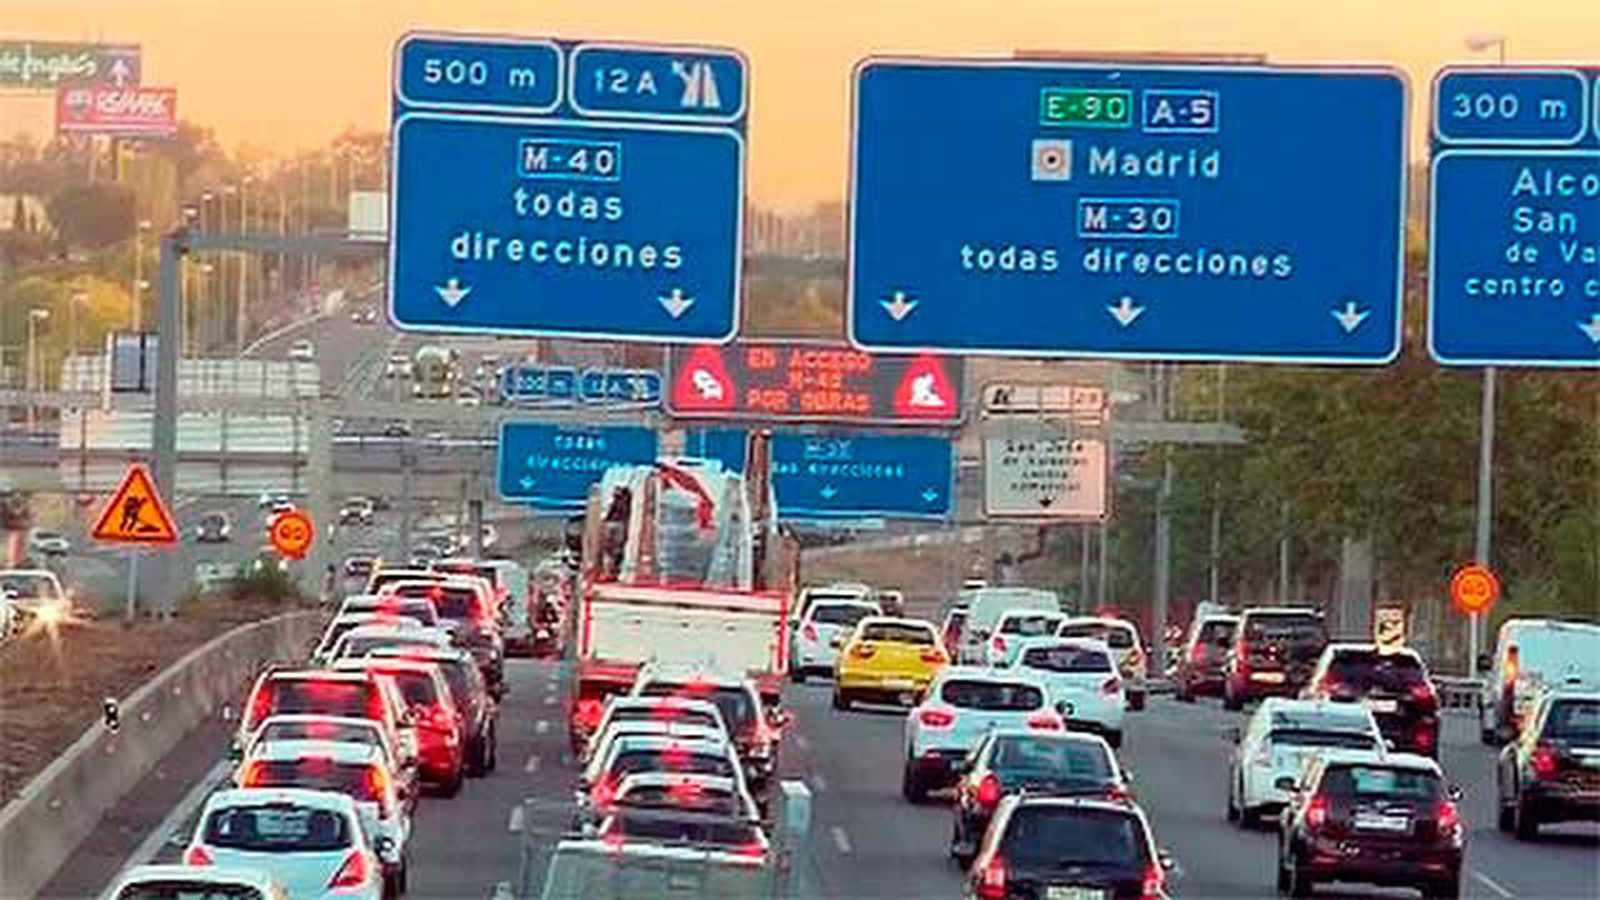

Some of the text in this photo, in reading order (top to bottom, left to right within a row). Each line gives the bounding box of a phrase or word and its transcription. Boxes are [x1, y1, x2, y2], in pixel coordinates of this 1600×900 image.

[423, 60, 536, 86] 500 m
[594, 68, 658, 95] 12A
[1045, 94, 1213, 124] E-90 A-5
[1452, 93, 1566, 119] 300 m
[523, 146, 614, 174] M-40
[1088, 147, 1221, 178] Madrid
[1512, 167, 1600, 197] Alco
[513, 187, 623, 219] todas
[1083, 206, 1173, 231] M-30
[1512, 207, 1577, 232] San
[450, 231, 683, 269] direcciones
[960, 244, 1292, 278] todas direcciones
[1506, 242, 1539, 263] de
[1465, 276, 1565, 296] centro
[748, 348, 872, 371] EN ACCESO
[747, 389, 872, 412] POR OBRAS
